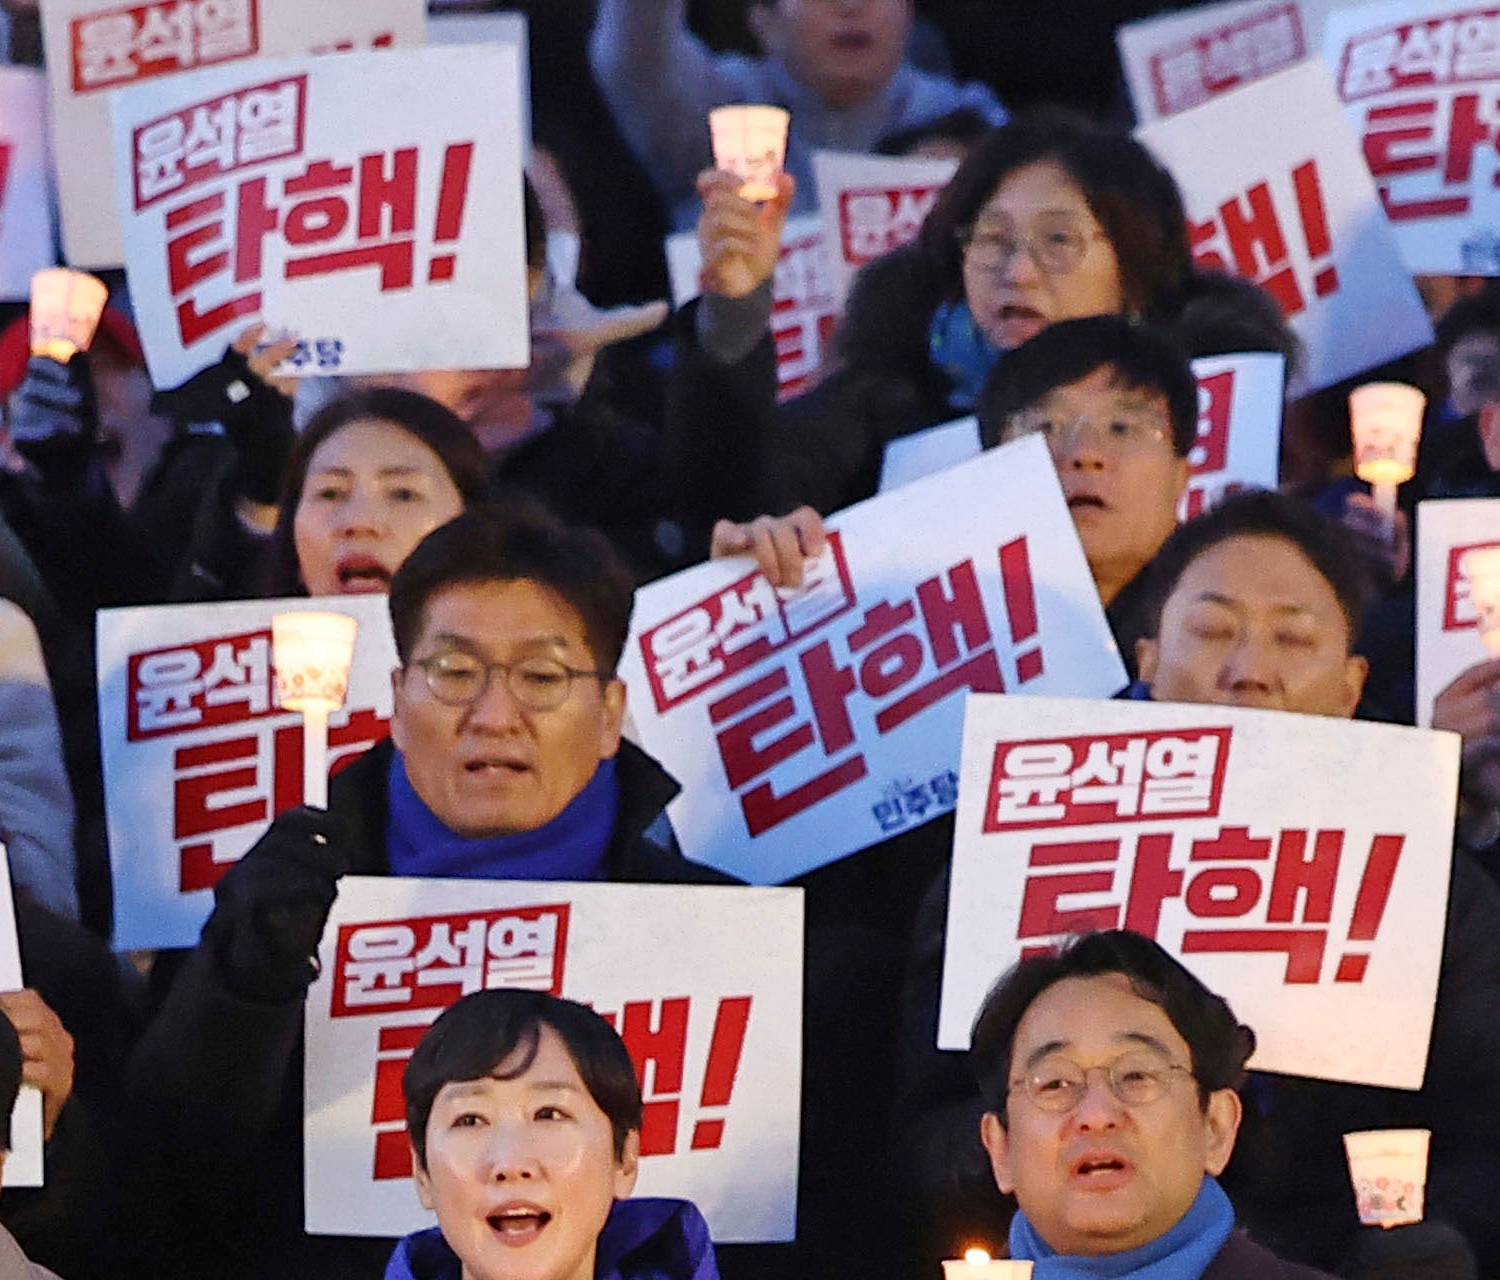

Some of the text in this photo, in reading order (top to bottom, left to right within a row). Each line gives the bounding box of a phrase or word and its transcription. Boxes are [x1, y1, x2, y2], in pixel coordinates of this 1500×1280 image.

[140, 82, 298, 197] 윤석열
[165, 141, 475, 349] 탄핵!
[137, 651, 275, 736] 윤석
[707, 535, 1043, 838] 탄핵!
[996, 734, 1219, 822] 윤석열
[344, 914, 556, 1006] 윤석열
[1018, 826, 1405, 985] 탄핵!
